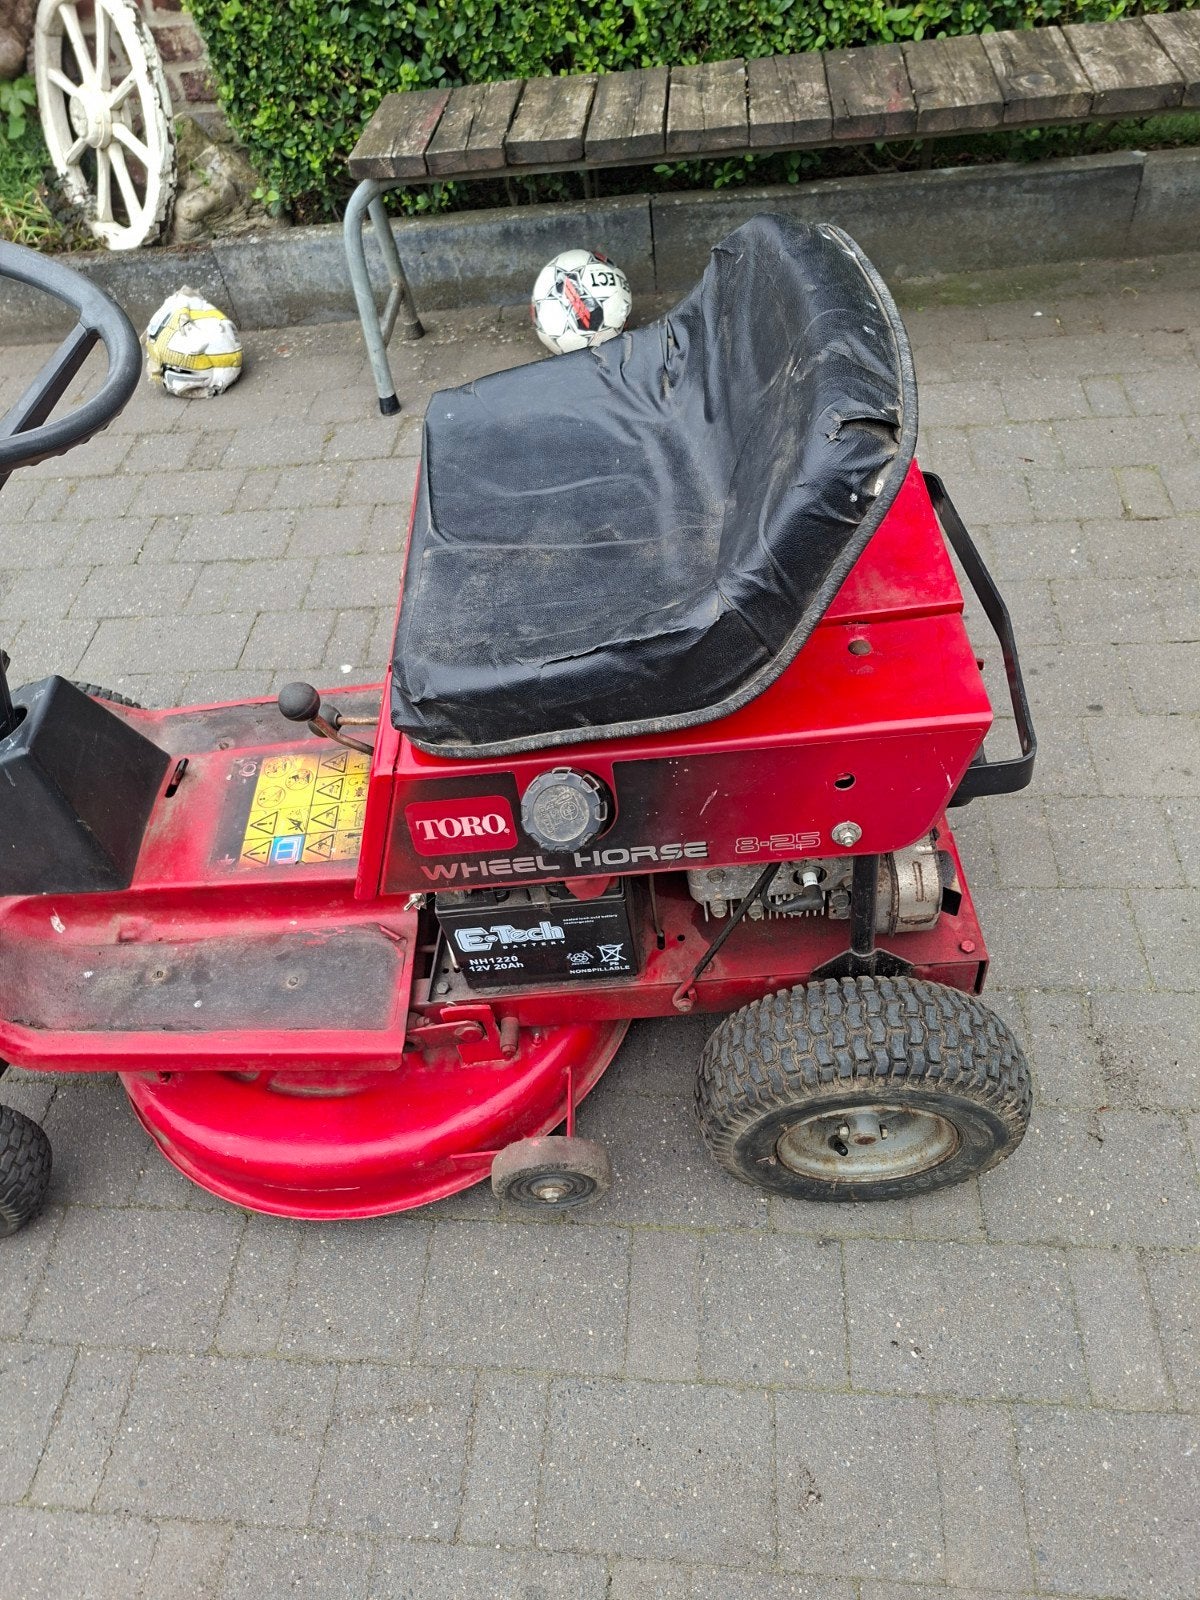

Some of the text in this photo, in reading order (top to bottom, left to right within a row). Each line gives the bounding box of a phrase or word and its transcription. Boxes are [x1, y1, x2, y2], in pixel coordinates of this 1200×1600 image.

[735, 831, 821, 854] 8-25
[420, 841, 708, 881] WHEEL HORSE
[502, 940, 566, 950] BATTERY
[469, 955, 519, 966] NH1220
[469, 961, 525, 973] 12V 20Ah
[569, 965, 630, 975] NONSPILLABLE
